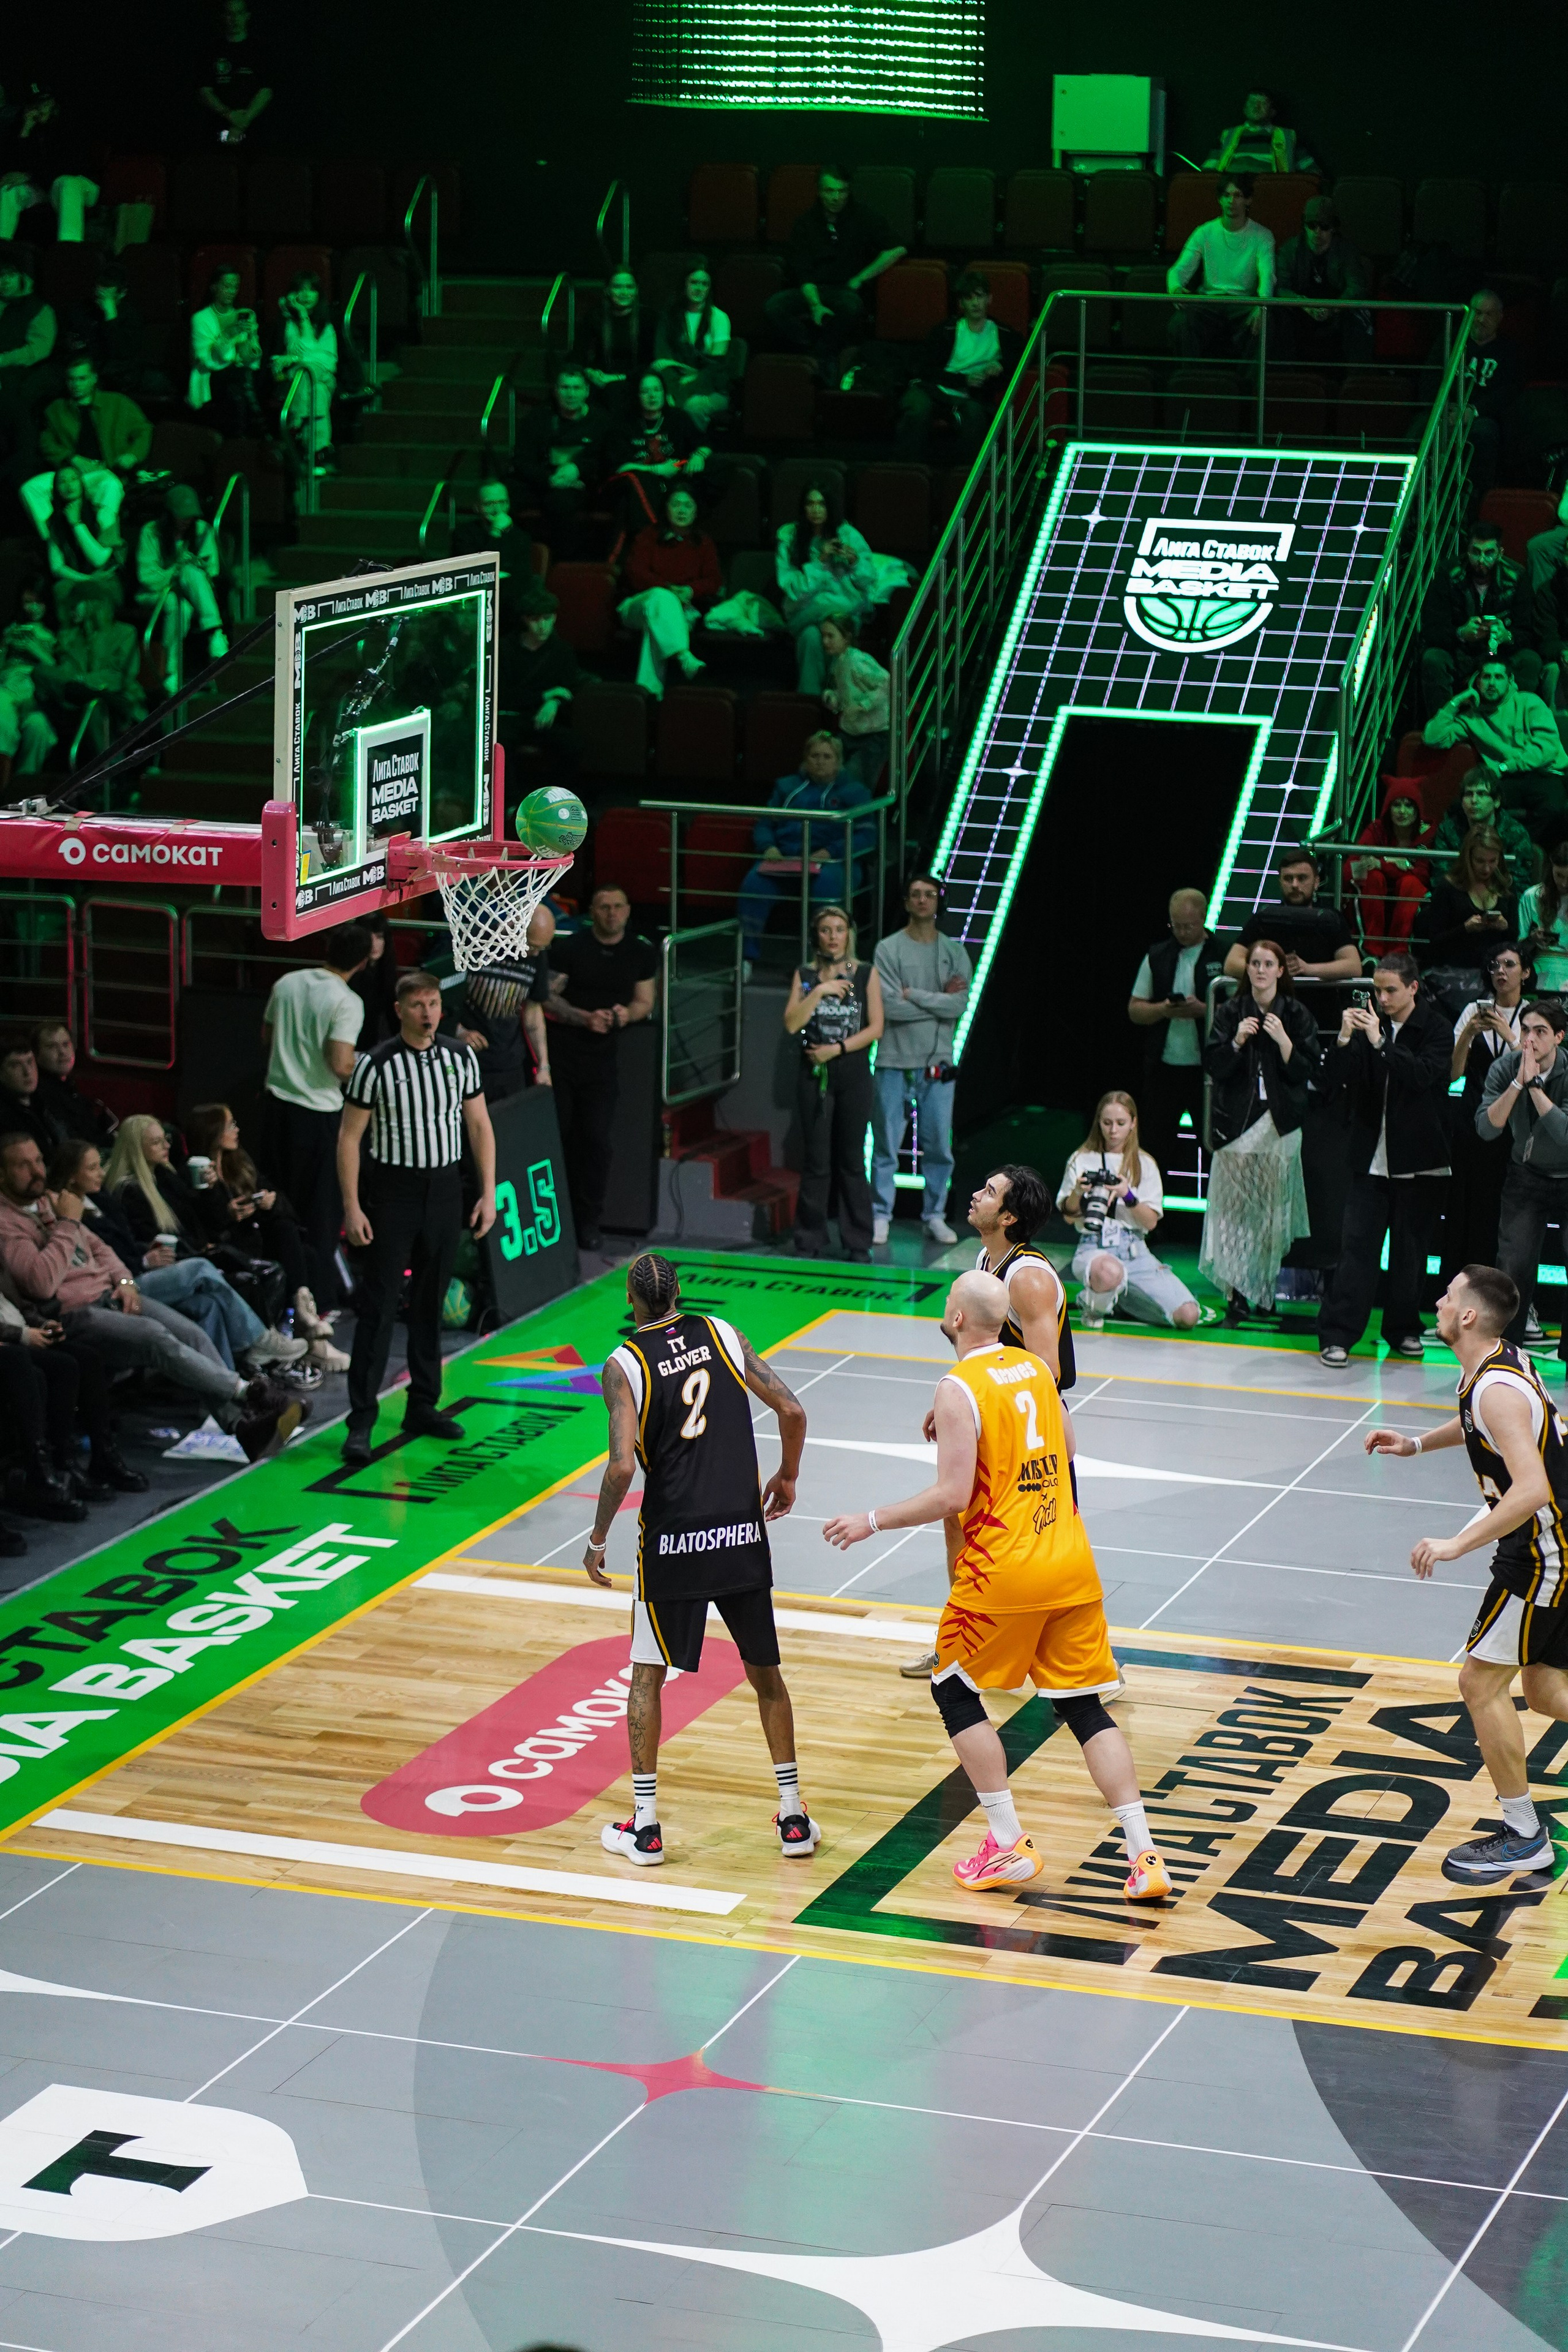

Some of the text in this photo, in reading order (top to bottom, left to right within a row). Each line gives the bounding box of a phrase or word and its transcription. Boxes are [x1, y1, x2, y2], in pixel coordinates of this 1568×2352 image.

[1130, 557, 1280, 584] MEDIA
[1125, 578, 1279, 599] BASKET
[372, 776, 419, 807] MEDIA
[371, 796, 419, 824] BASKET
[92, 843, 224, 866] самокат
[495, 1158, 562, 1262] 3.5
[666, 1335, 687, 1354] TY
[657, 1345, 712, 1378] GLOVER
[680, 1367, 710, 1439] 2
[1015, 1390, 1045, 1450] 2
[658, 1521, 762, 1555] BLATOSPHERA
[48, 1523, 399, 1700] BASKET
[1150, 1696, 1528, 1992] MEDIA
